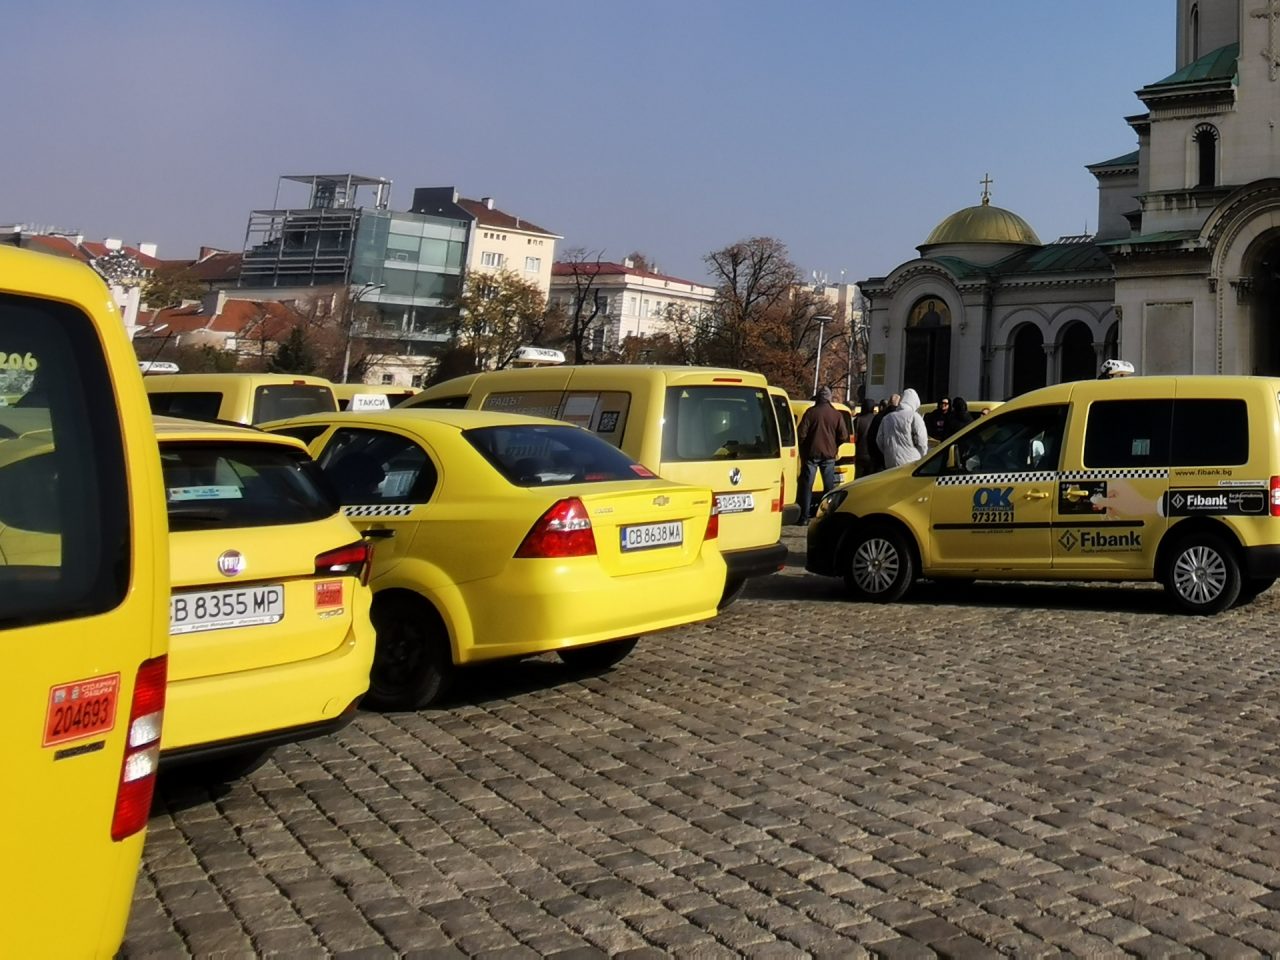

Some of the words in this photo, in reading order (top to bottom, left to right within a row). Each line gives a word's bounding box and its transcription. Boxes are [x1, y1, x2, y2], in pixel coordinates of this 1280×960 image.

[358, 399, 385, 407] ТАКСИ
[1175, 469, 1232, 477] www.fibank.bg
[972, 487, 1015, 508] OK
[1187, 494, 1228, 507] Fibank
[972, 512, 1015, 522] 9732121
[628, 529, 642, 545] CB
[644, 526, 668, 543] 8638
[669, 524, 681, 541] MA
[1081, 530, 1142, 547] Fibank
[171, 599, 188, 622] B
[195, 592, 248, 620] 8355
[253, 589, 279, 613] MP
[52, 697, 109, 736] 204693
